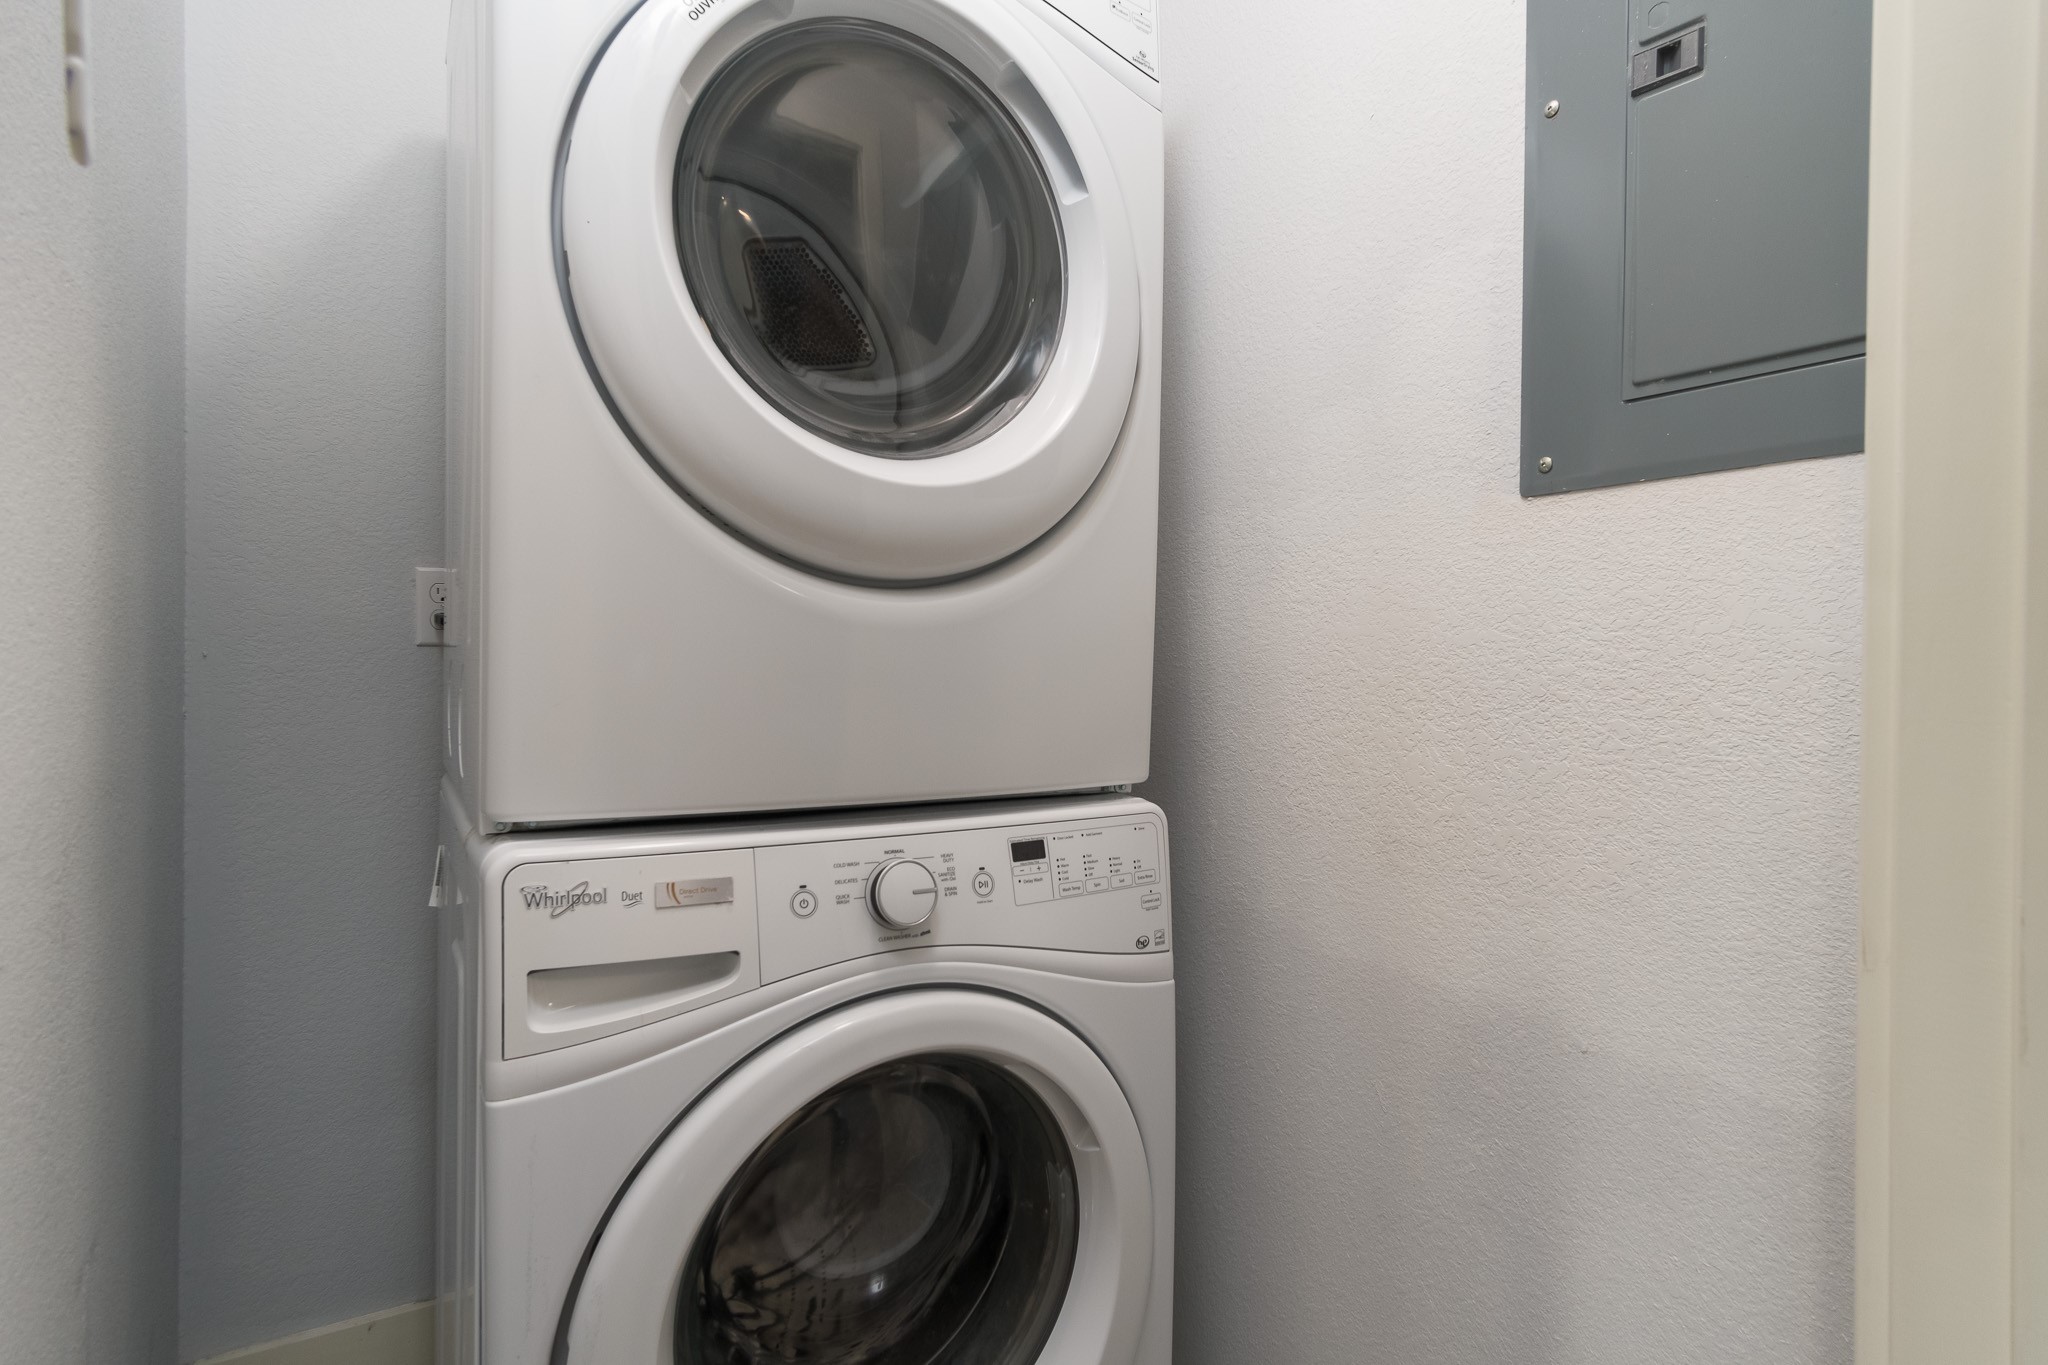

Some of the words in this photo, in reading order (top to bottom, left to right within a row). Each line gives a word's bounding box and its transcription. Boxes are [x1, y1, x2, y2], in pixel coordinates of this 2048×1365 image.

[523, 886, 607, 912] Whirlpool
[621, 889, 643, 902] Duet
[680, 887, 699, 895] Direct
